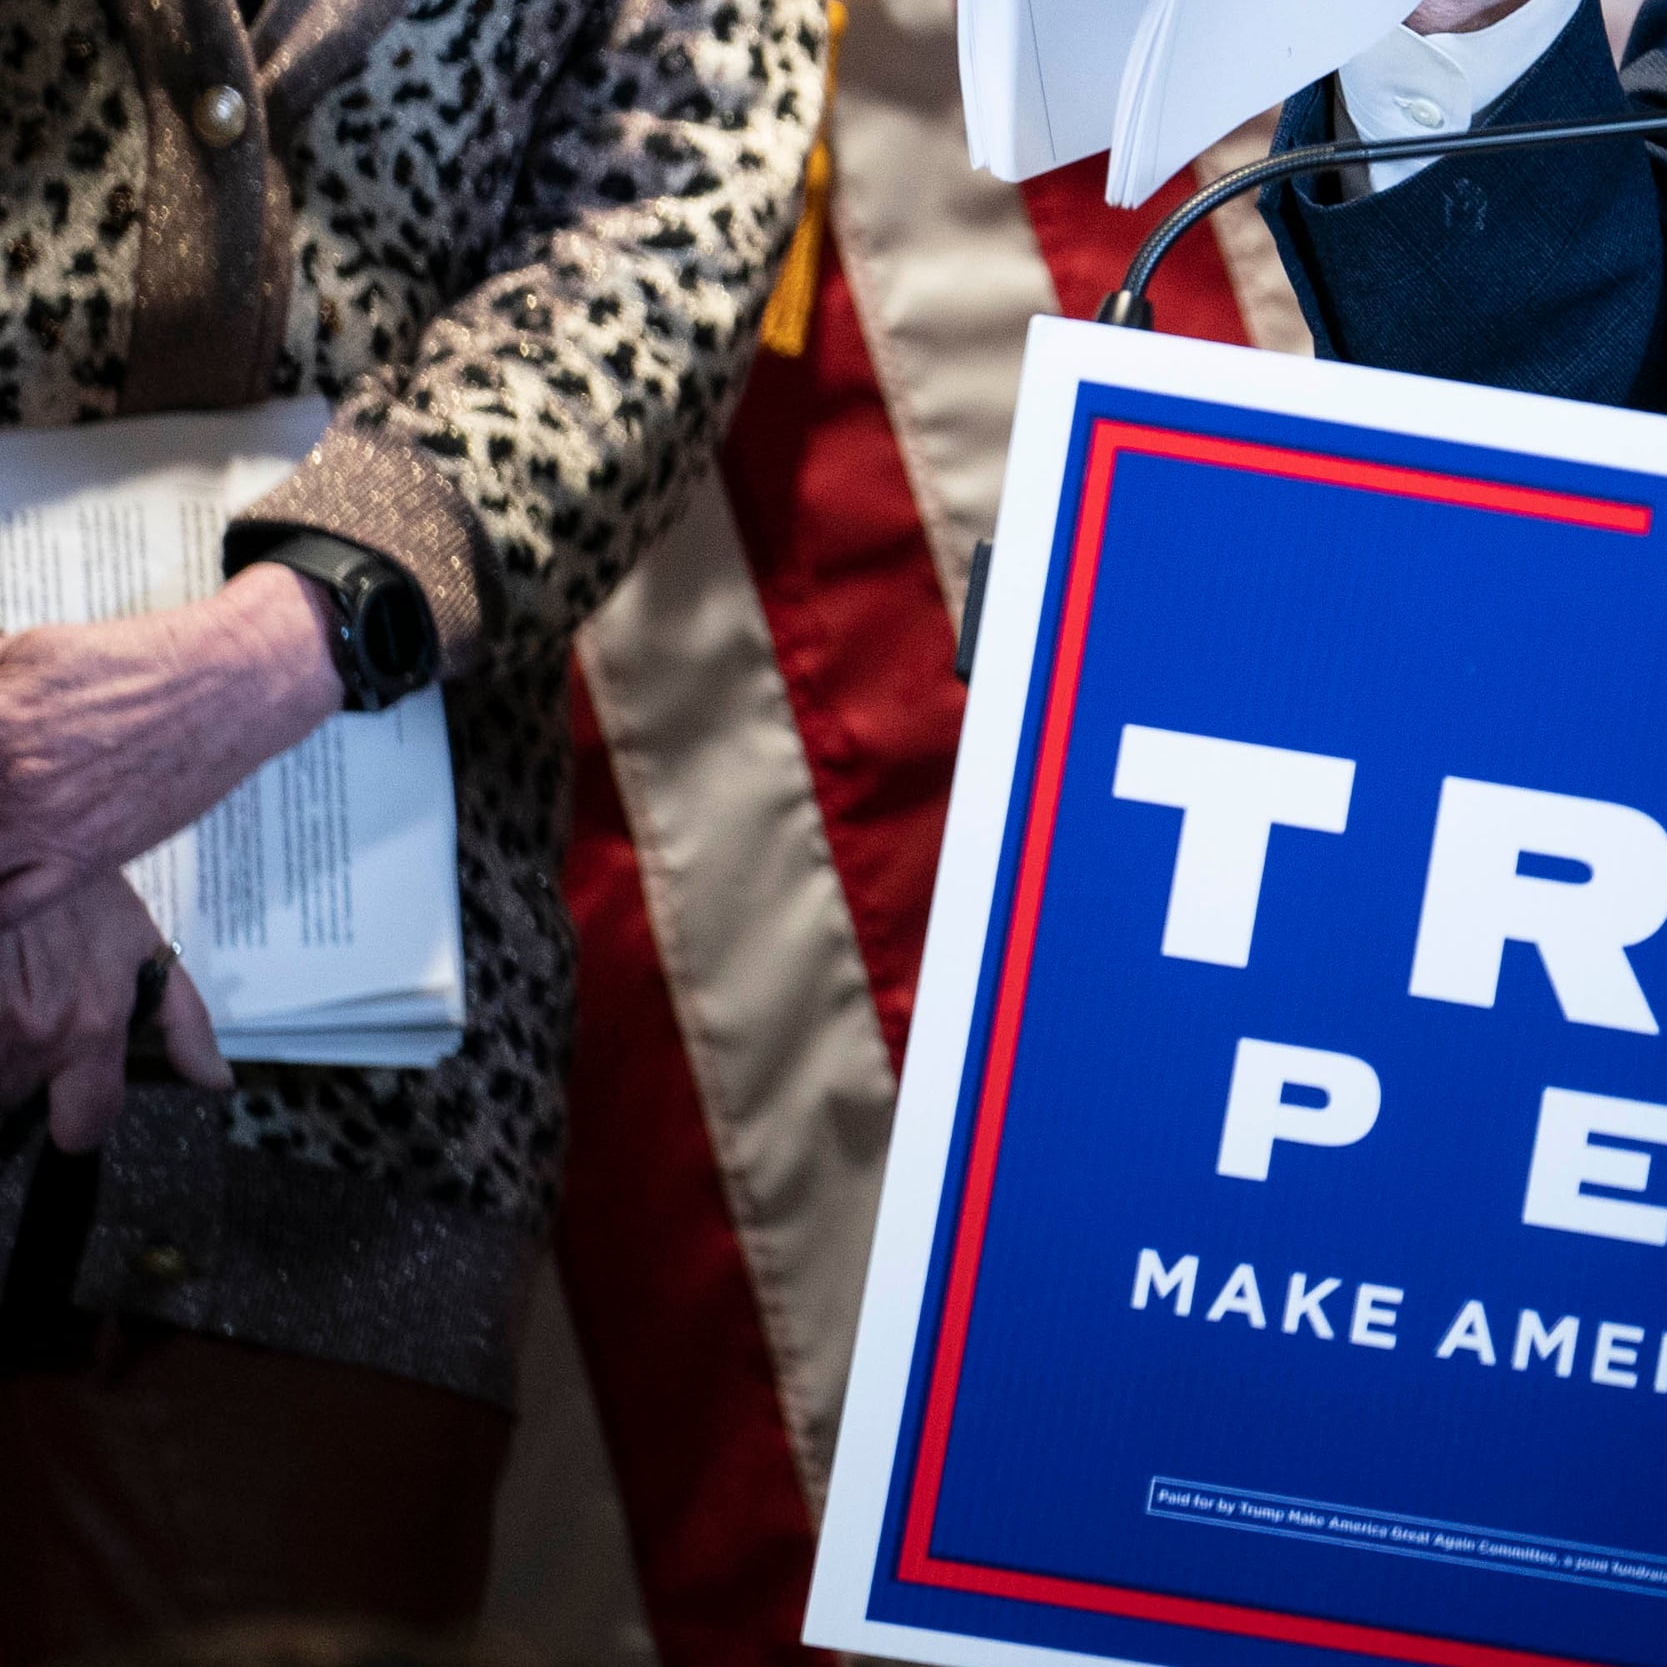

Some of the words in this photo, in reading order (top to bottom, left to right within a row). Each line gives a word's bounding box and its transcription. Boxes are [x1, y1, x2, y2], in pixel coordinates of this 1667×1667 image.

[1132, 1248, 1404, 1350] MAKE
[1157, 1488, 1191, 1508] Paid
[1193, 1496, 1214, 1512] for
[1218, 1498, 1236, 1515] by
[1239, 1501, 1285, 1523] Trump
[1288, 1510, 1325, 1529] Make
[1328, 1516, 1388, 1540] America
[1391, 1526, 1431, 1546] Great
[1433, 1533, 1476, 1552] Again
[1477, 1539, 1560, 1567] Committee,
[1575, 1555, 1609, 1574] joint
